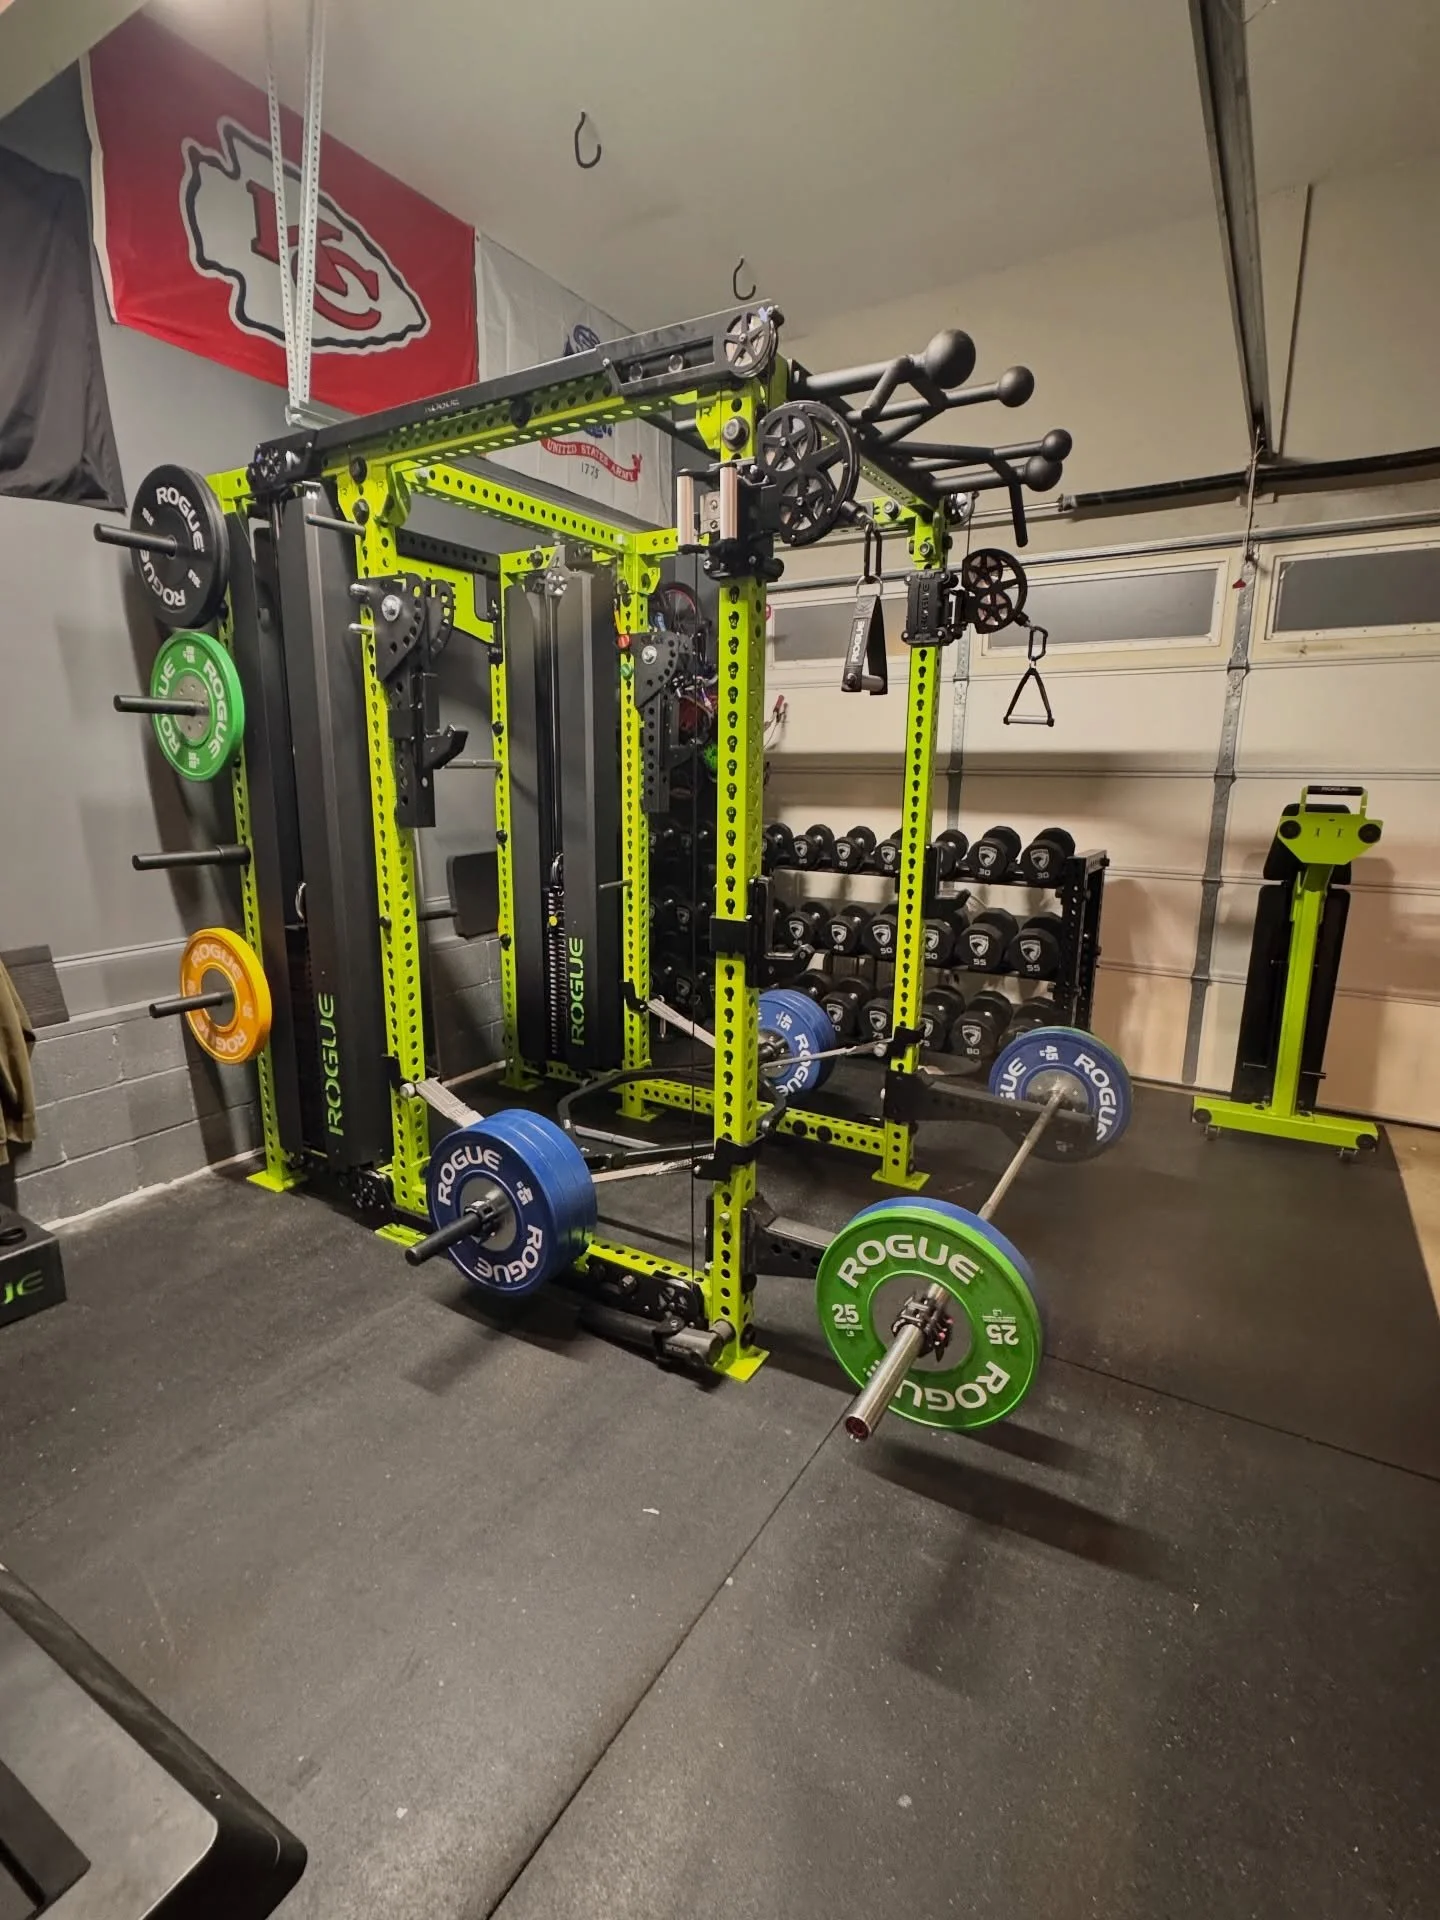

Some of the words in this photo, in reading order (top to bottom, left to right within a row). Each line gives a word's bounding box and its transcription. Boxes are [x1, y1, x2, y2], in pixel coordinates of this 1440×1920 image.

[547, 439, 577, 455] UNITED
[581, 444, 608, 466] STATES
[611, 463, 634, 481] ARMY
[581, 462, 600, 480] 1775
[155, 486, 204, 552] ROGUE
[158, 658, 181, 755] ROUE
[203, 659, 227, 759] ROGUE
[1037, 871, 1049, 879] 30
[191, 943, 244, 982] ROGUE
[880, 947, 893, 955] 50
[973, 958, 987, 966] 55
[1026, 964, 1040, 972] 55
[569, 937, 585, 1046] ROGUE
[318, 992, 344, 1136] ROGUE
[776, 1033, 811, 1097] ROGUE
[437, 1145, 503, 1206] ROGUE
[474, 1224, 543, 1284] ROGUE
[837, 1234, 981, 1289] ROGUE
[831, 1303, 860, 1324] 25
[985, 1323, 1020, 1346] 25
[864, 1359, 1011, 1412] ROGU
